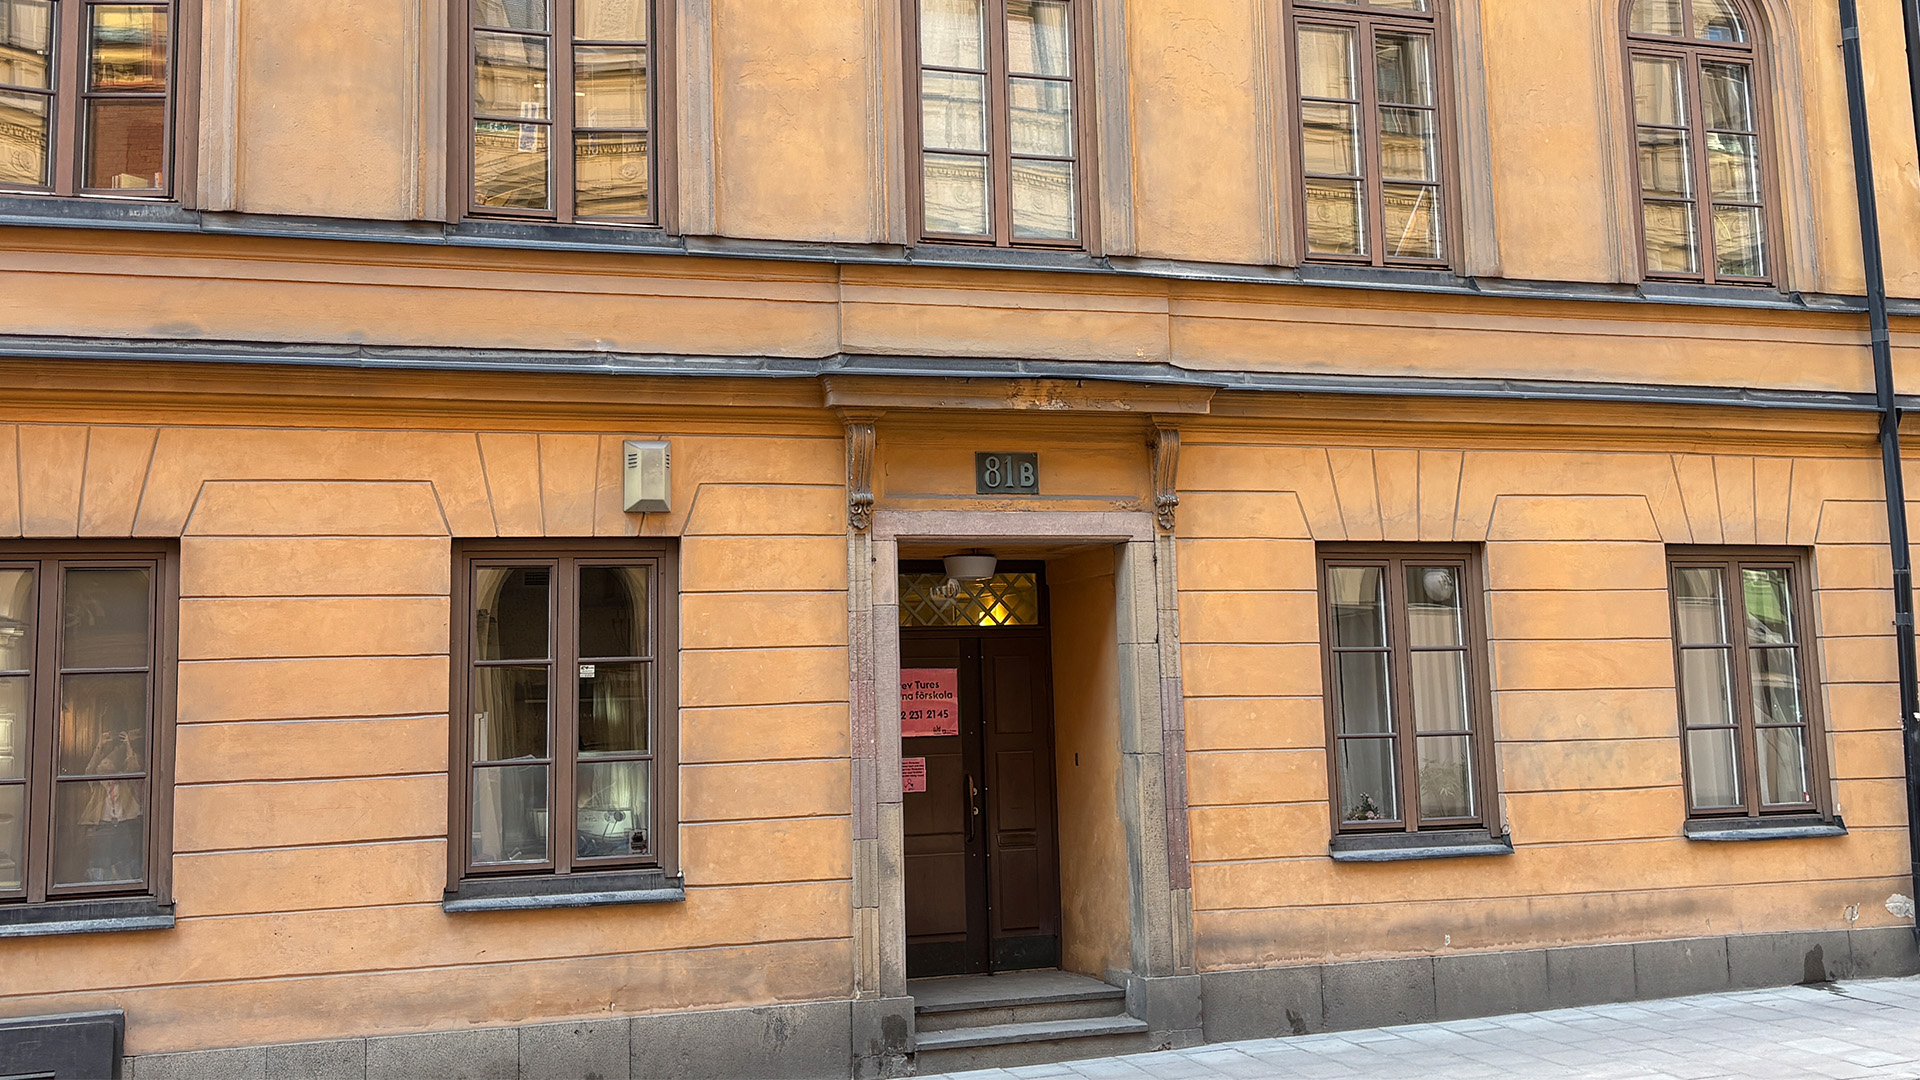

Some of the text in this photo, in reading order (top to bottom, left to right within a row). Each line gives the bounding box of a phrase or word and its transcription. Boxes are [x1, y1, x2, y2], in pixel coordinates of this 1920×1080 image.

[901, 680, 940, 690] ev Tures
[901, 690, 953, 701] na förskola
[909, 709, 923, 719] 231
